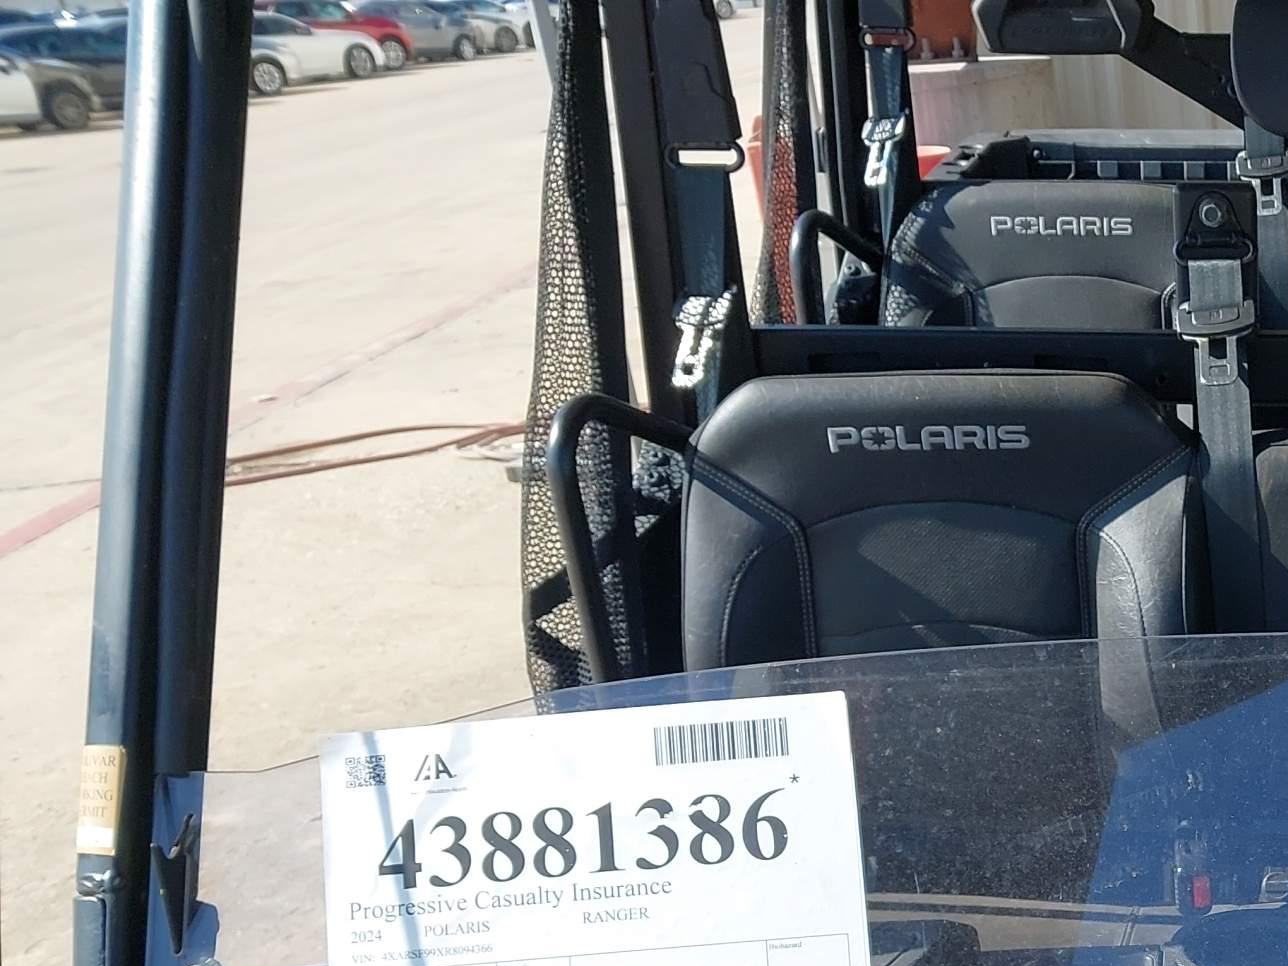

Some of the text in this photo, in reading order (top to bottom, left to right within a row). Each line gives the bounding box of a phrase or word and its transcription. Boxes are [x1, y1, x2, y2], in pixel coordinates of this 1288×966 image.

[991, 216, 1133, 236] POLARIS
[827, 426, 1030, 453] POLARIS
[378, 788, 789, 890] 43881386
[350, 878, 673, 922] Progressive Casualty Insurance
[351, 907, 650, 943] 2024 POLARIS RANGER
